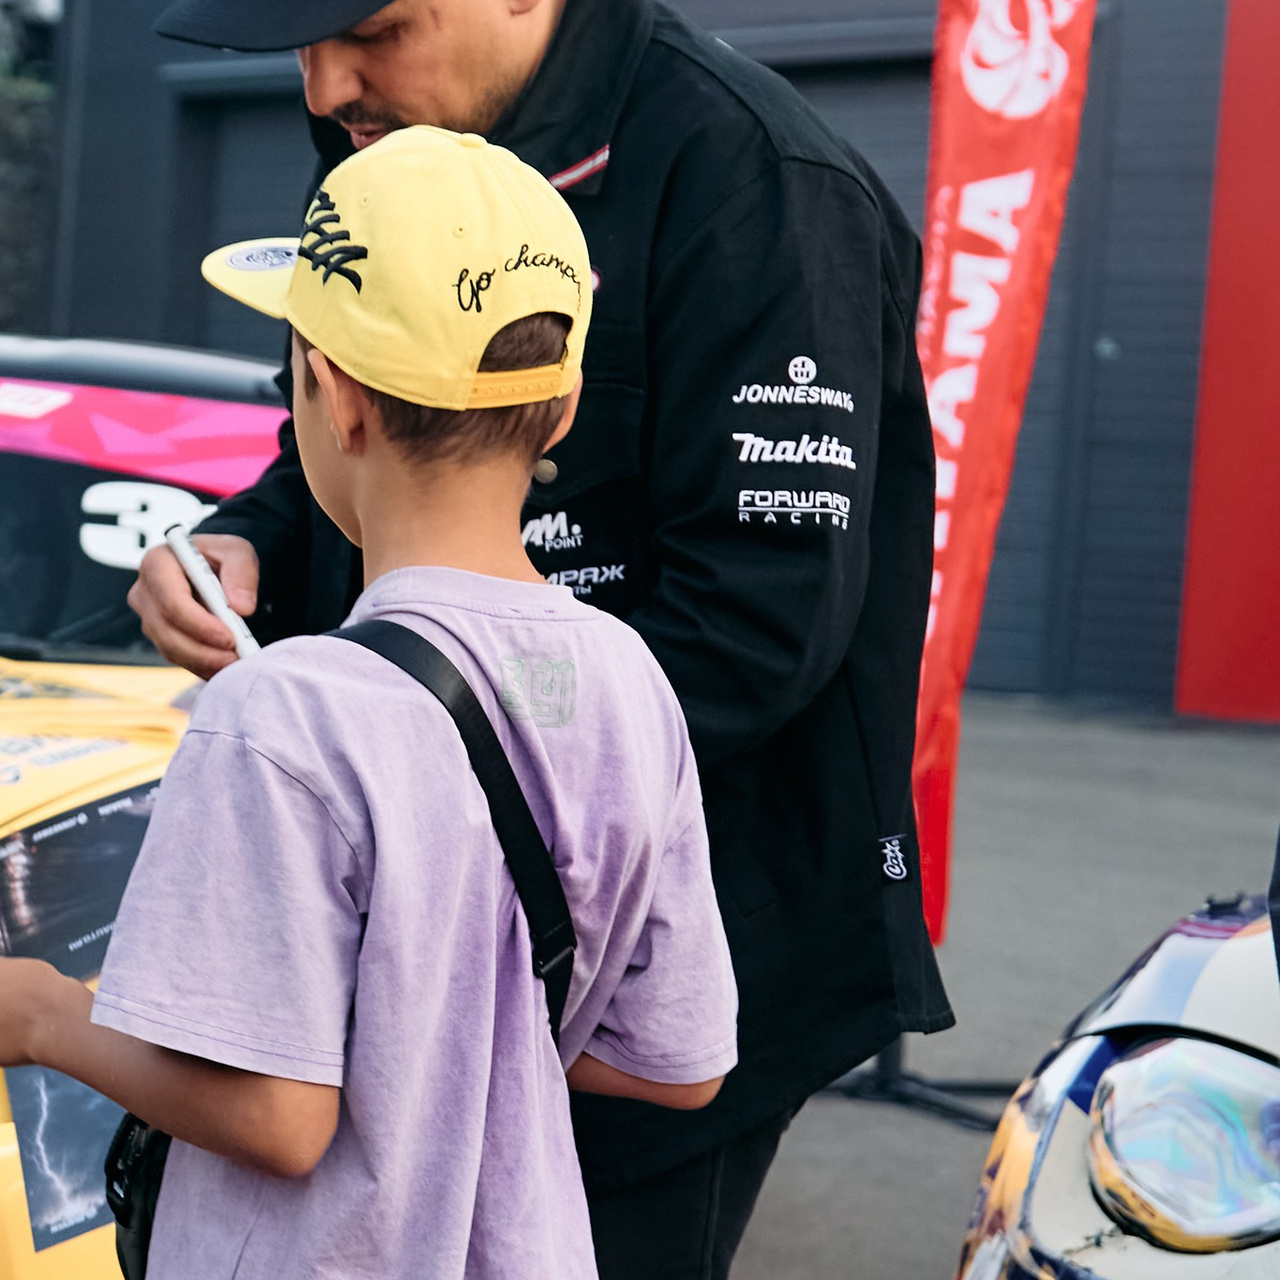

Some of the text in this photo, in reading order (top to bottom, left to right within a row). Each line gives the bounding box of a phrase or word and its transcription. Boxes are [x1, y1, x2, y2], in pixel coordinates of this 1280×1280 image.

[738, 489, 851, 513] FORWARD
[738, 511, 849, 531] RACING
[545, 535, 584, 553] POINT
